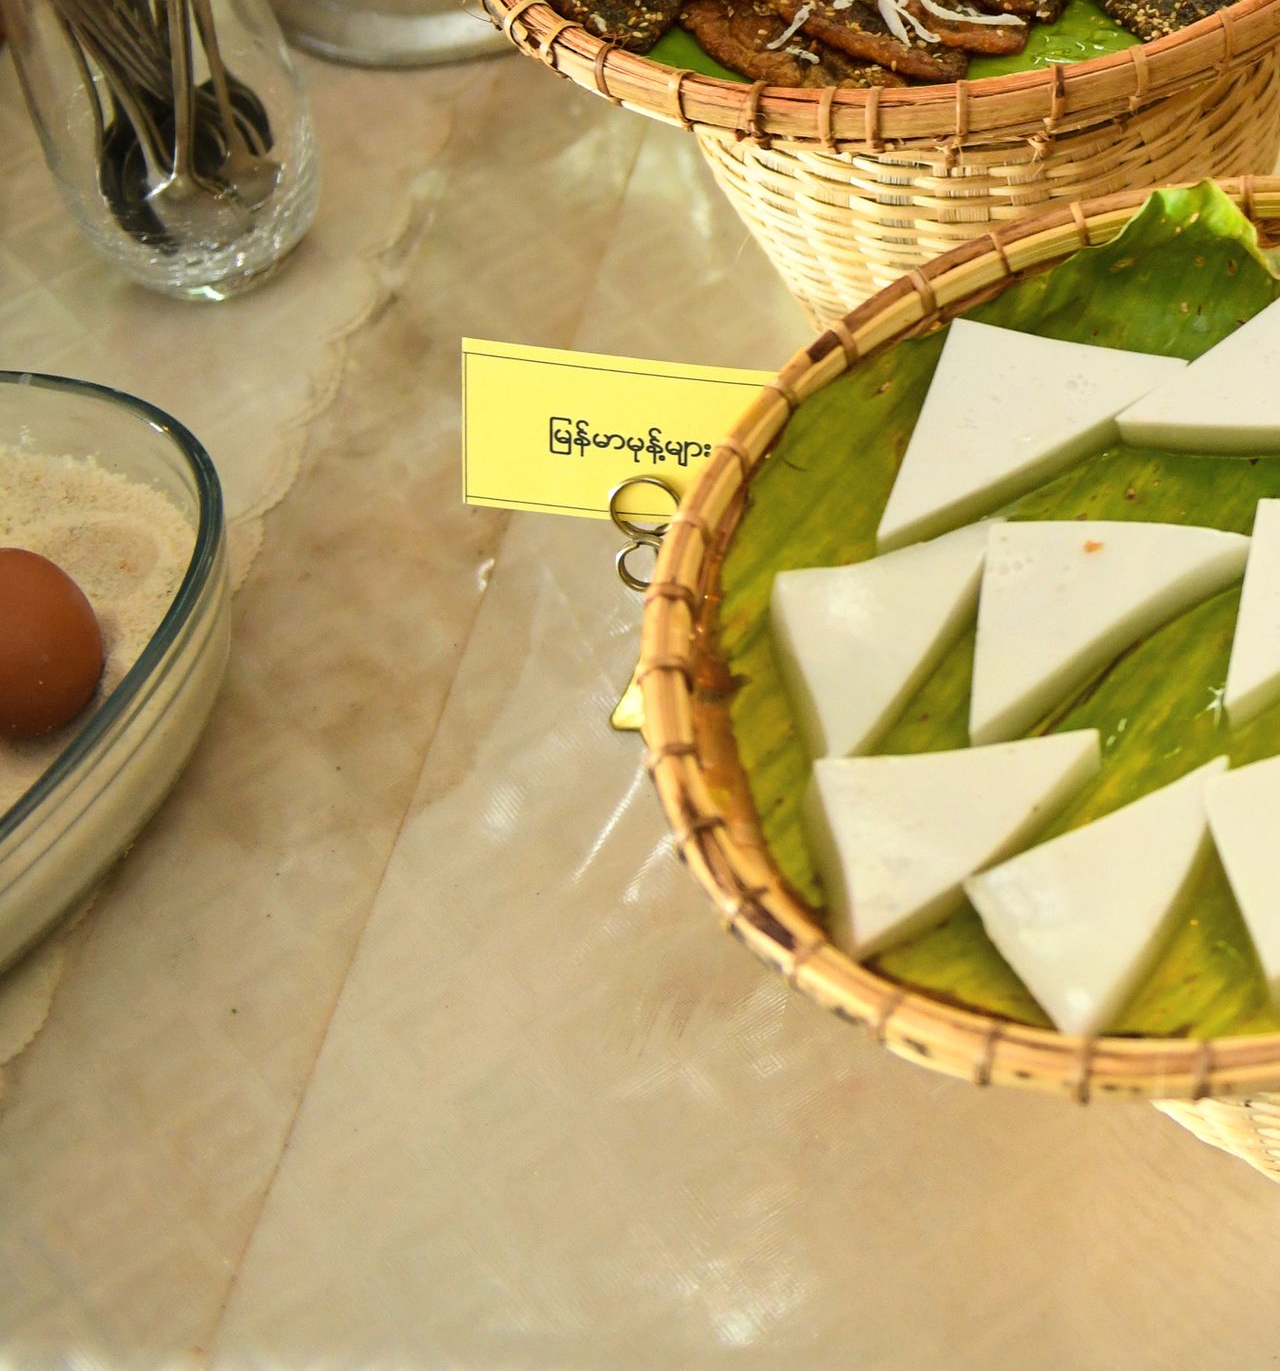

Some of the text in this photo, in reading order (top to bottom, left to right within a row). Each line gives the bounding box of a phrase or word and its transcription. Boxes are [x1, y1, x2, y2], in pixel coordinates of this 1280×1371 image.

[549, 416, 711, 466] မြန်မာမုန့်များ
